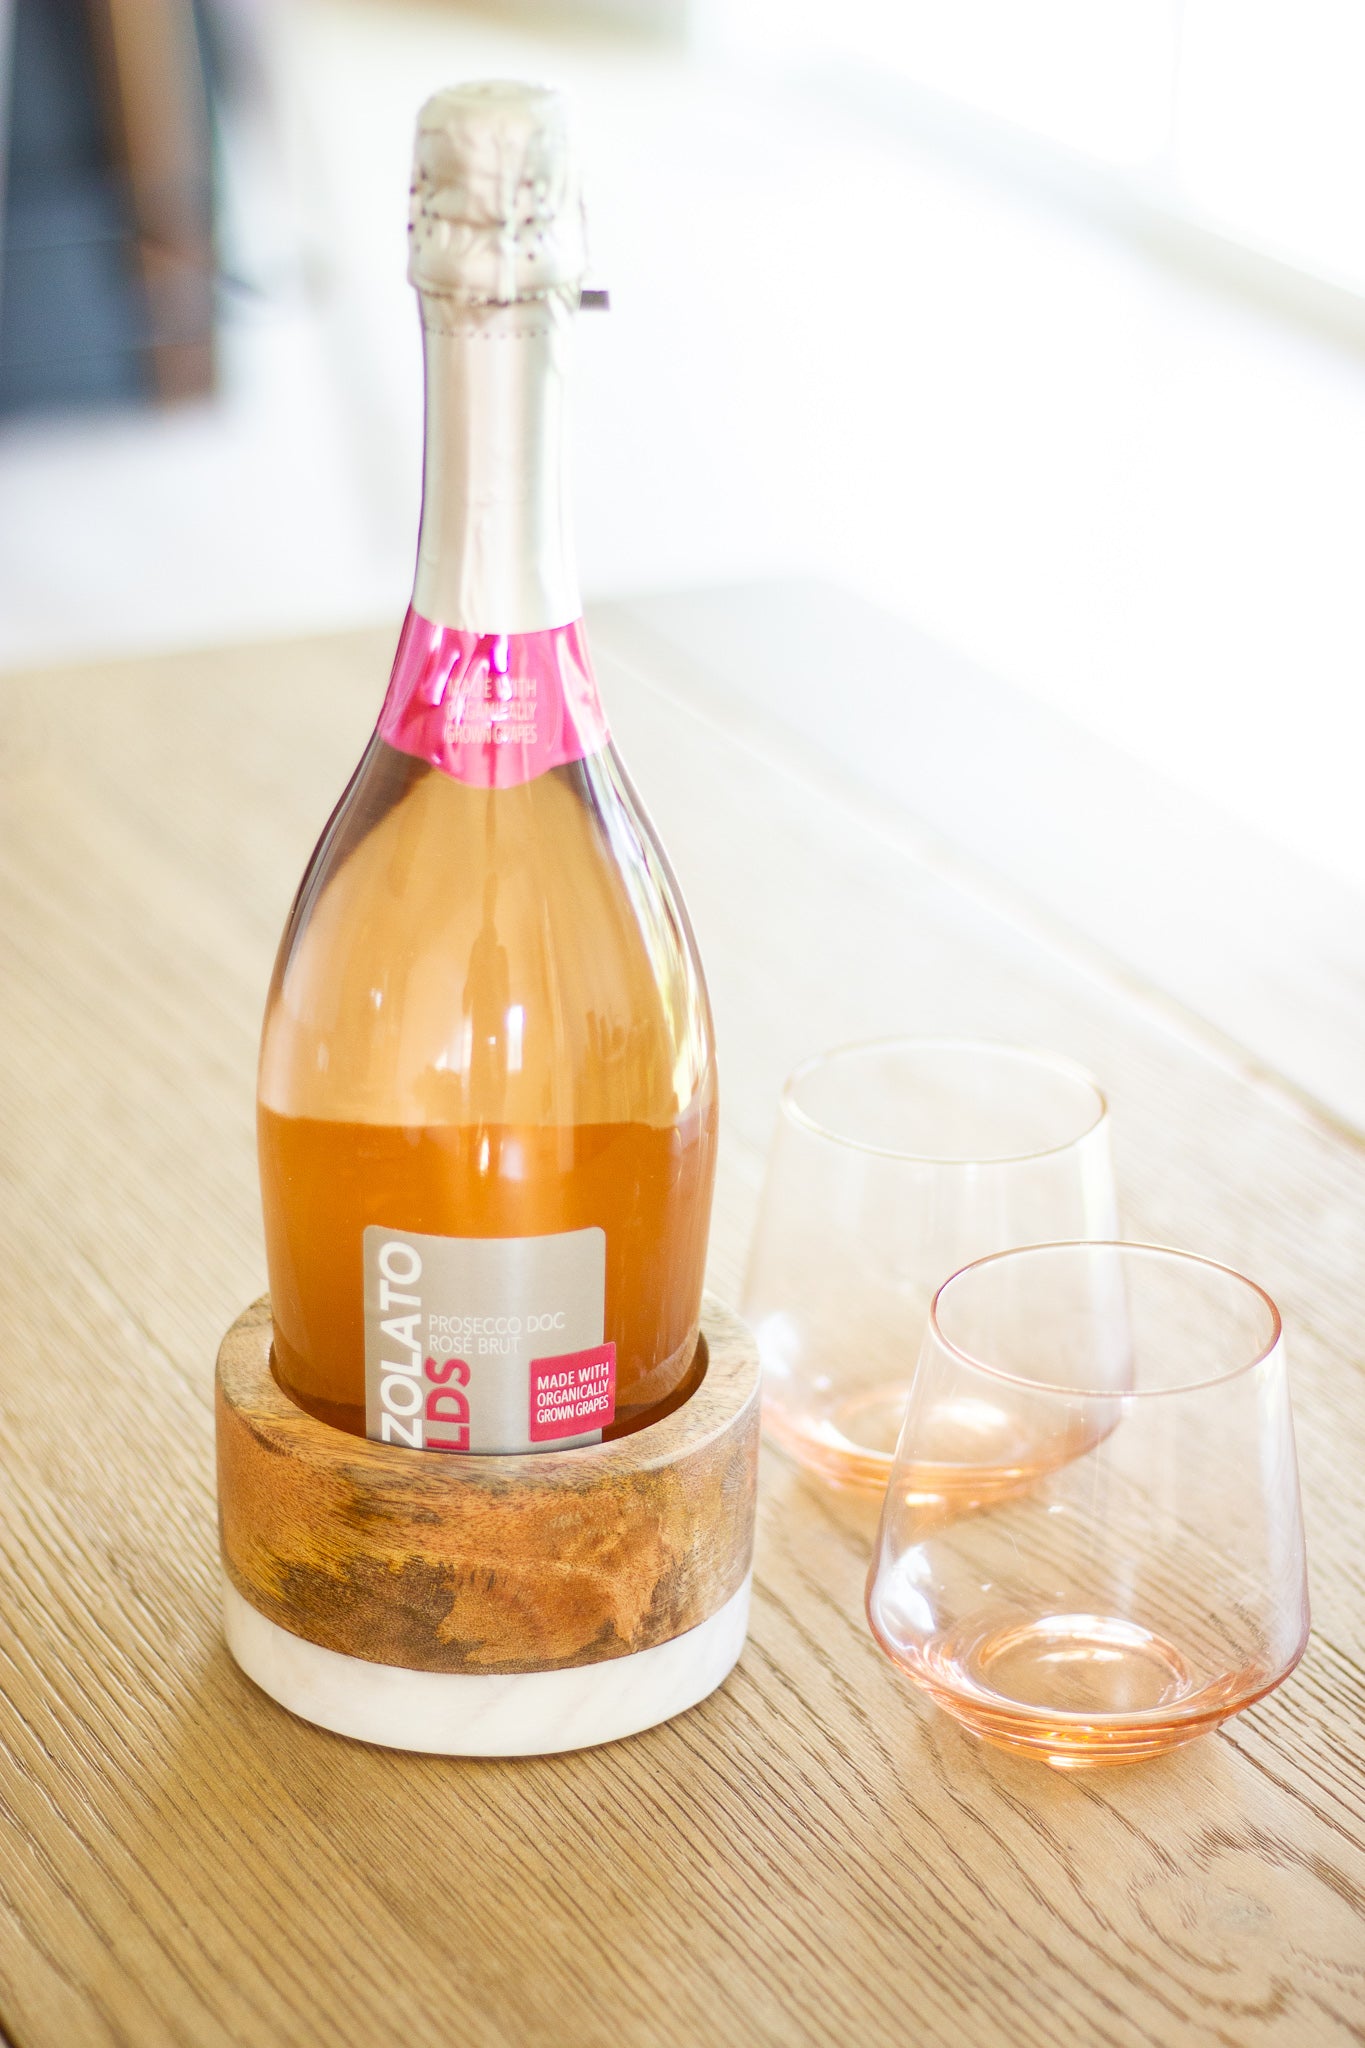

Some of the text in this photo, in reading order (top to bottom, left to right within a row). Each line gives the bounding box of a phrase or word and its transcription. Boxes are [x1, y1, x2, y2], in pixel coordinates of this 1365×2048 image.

[446, 725, 492, 744] GROWN
[429, 1311, 566, 1334] PROSECCO DOC
[429, 1330, 523, 1354] ROSÉ BRUT
[537, 1361, 609, 1390] MADE WITH
[537, 1377, 609, 1407] ORGANICALLY
[536, 1394, 609, 1423] GROWN GRAPES
